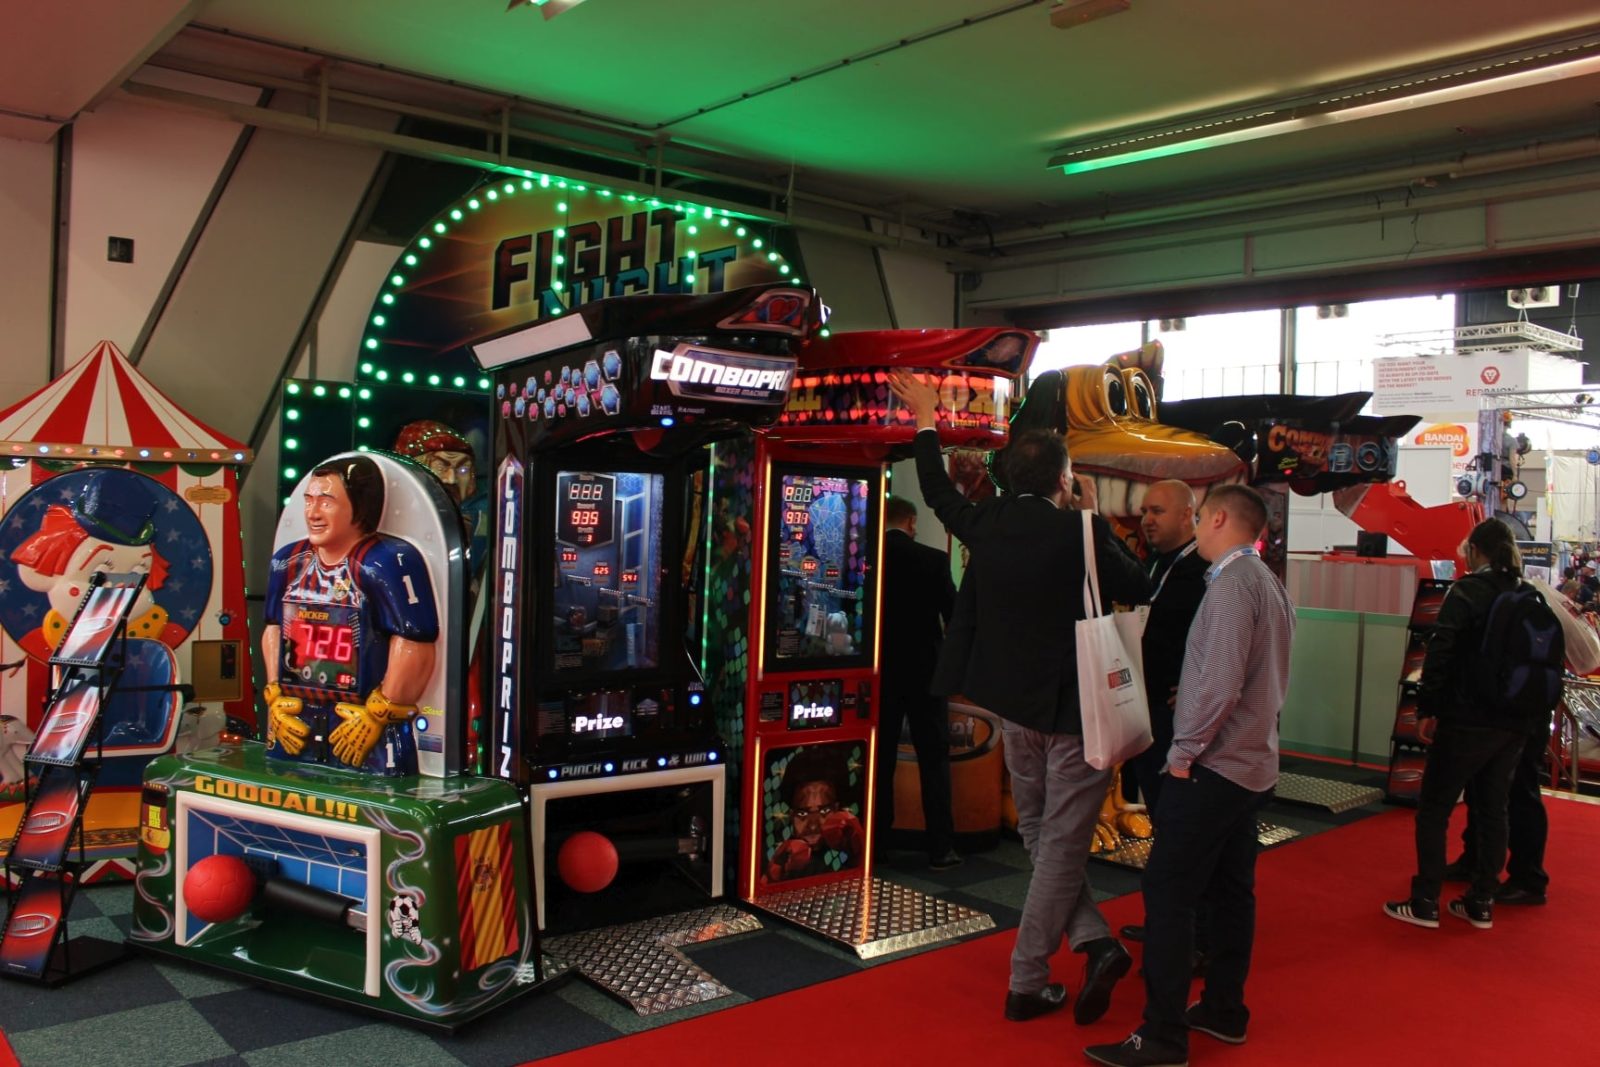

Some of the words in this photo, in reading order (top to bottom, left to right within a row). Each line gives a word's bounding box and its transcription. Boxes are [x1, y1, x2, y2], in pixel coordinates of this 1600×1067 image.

[492, 208, 686, 310] FIGHT
[1424, 433, 1464, 442] BANDAI
[572, 511, 598, 525] 935
[594, 567, 609, 575] 625
[402, 575, 419, 604] 1
[298, 611, 329, 620] KICKER
[300, 624, 352, 661] 726
[793, 702, 834, 719] Prize
[574, 713, 624, 732] Prize
[385, 743, 395, 768] 1
[561, 762, 601, 777] PUNCH
[622, 759, 649, 771] KICK
[684, 752, 707, 763] WIN
[195, 775, 358, 823] GOOOAL!!!
